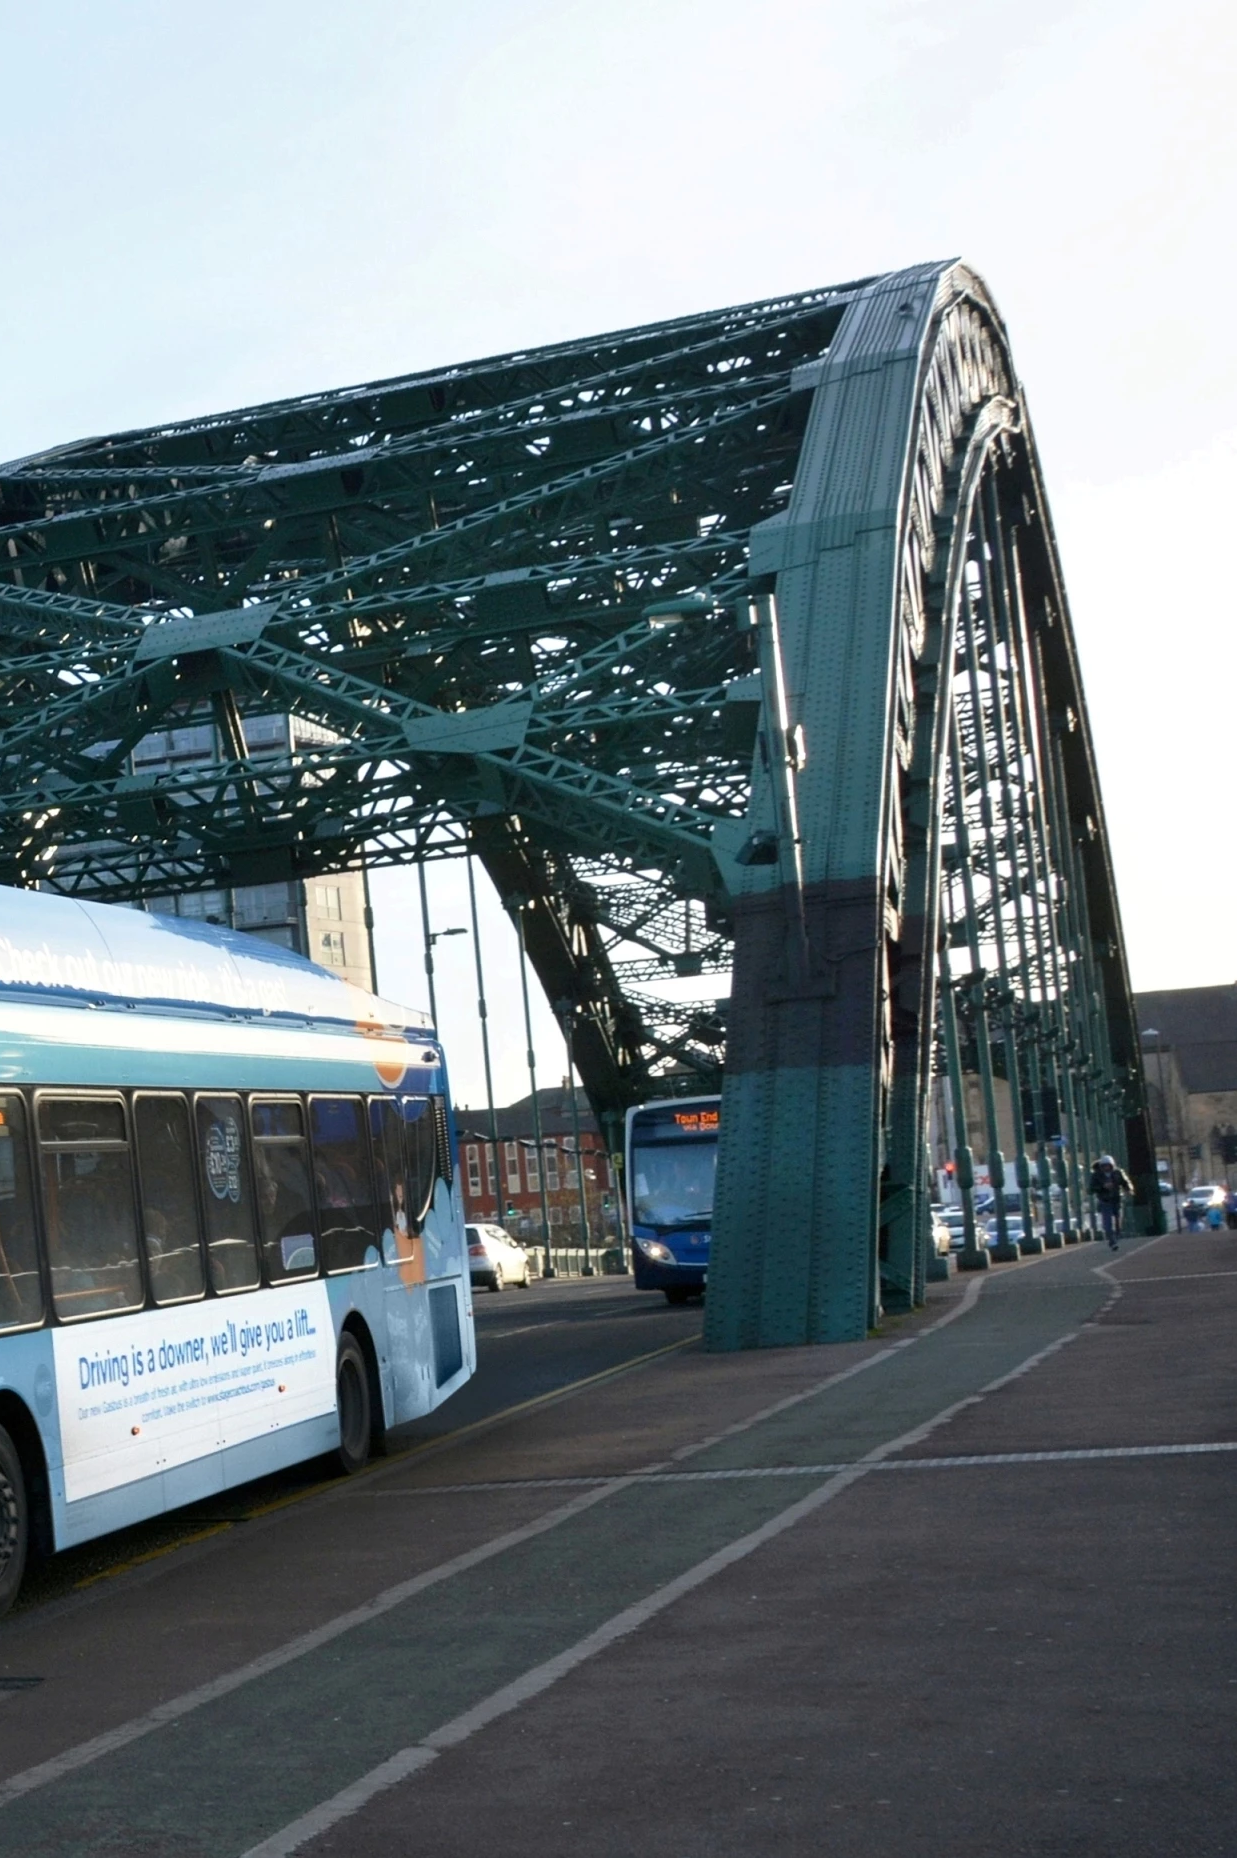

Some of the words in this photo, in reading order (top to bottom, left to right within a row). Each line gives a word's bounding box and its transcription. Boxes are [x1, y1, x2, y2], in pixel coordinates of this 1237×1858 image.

[700, 1112, 718, 1122] End
[79, 1352, 129, 1390] Driving
[131, 1344, 144, 1376] is
[147, 1348, 155, 1373] a
[158, 1338, 209, 1370] downer,
[210, 1319, 237, 1357] we'll
[240, 1320, 262, 1357] give
[265, 1320, 285, 1352] you
[287, 1318, 294, 1340] a
